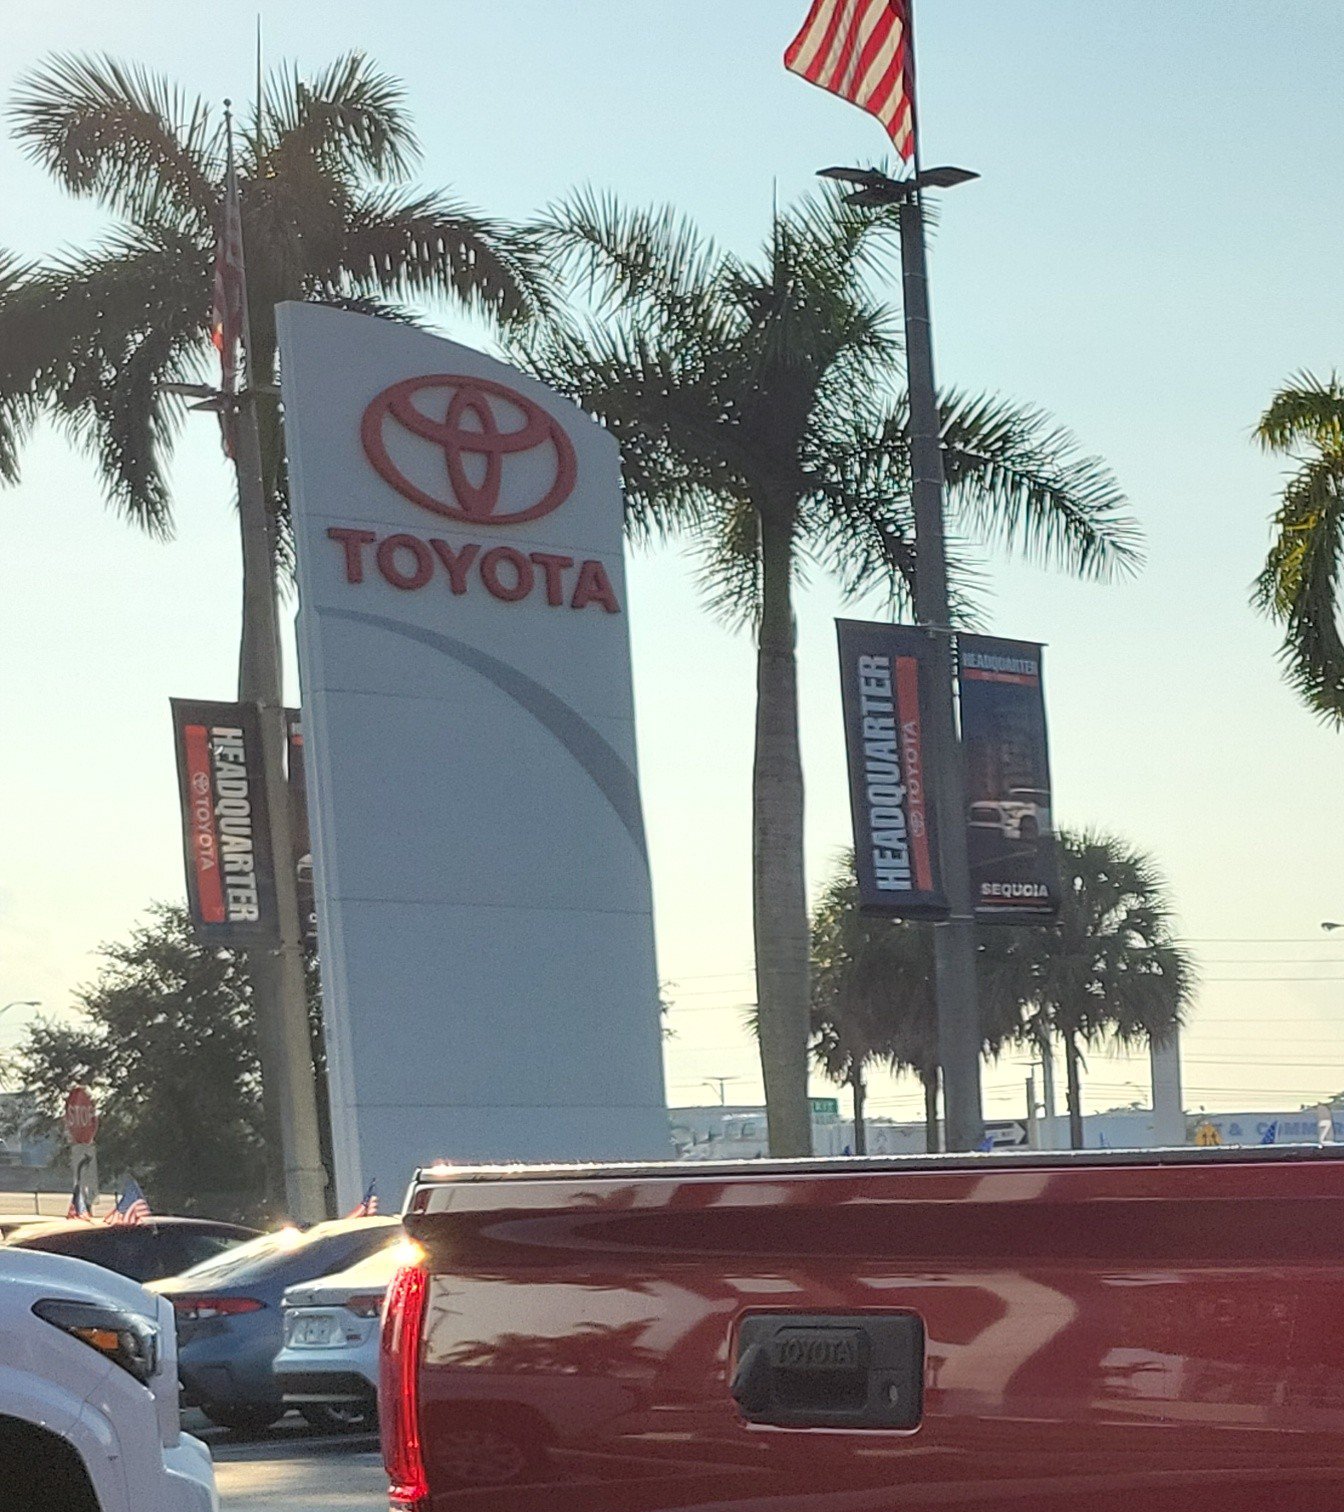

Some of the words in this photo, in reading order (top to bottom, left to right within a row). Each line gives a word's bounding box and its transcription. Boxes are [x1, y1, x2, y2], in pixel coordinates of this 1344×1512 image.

[327, 527, 621, 613] TOYOTA
[858, 655, 913, 891] HEADQUARTER
[903, 720, 923, 804] TOYOTA
[196, 797, 216, 871] TOYOTA
[212, 727, 259, 922] HEADQUARTER
[981, 882, 1049, 898] SEQUOIA
[775, 1338, 855, 1365] TOYOTA
